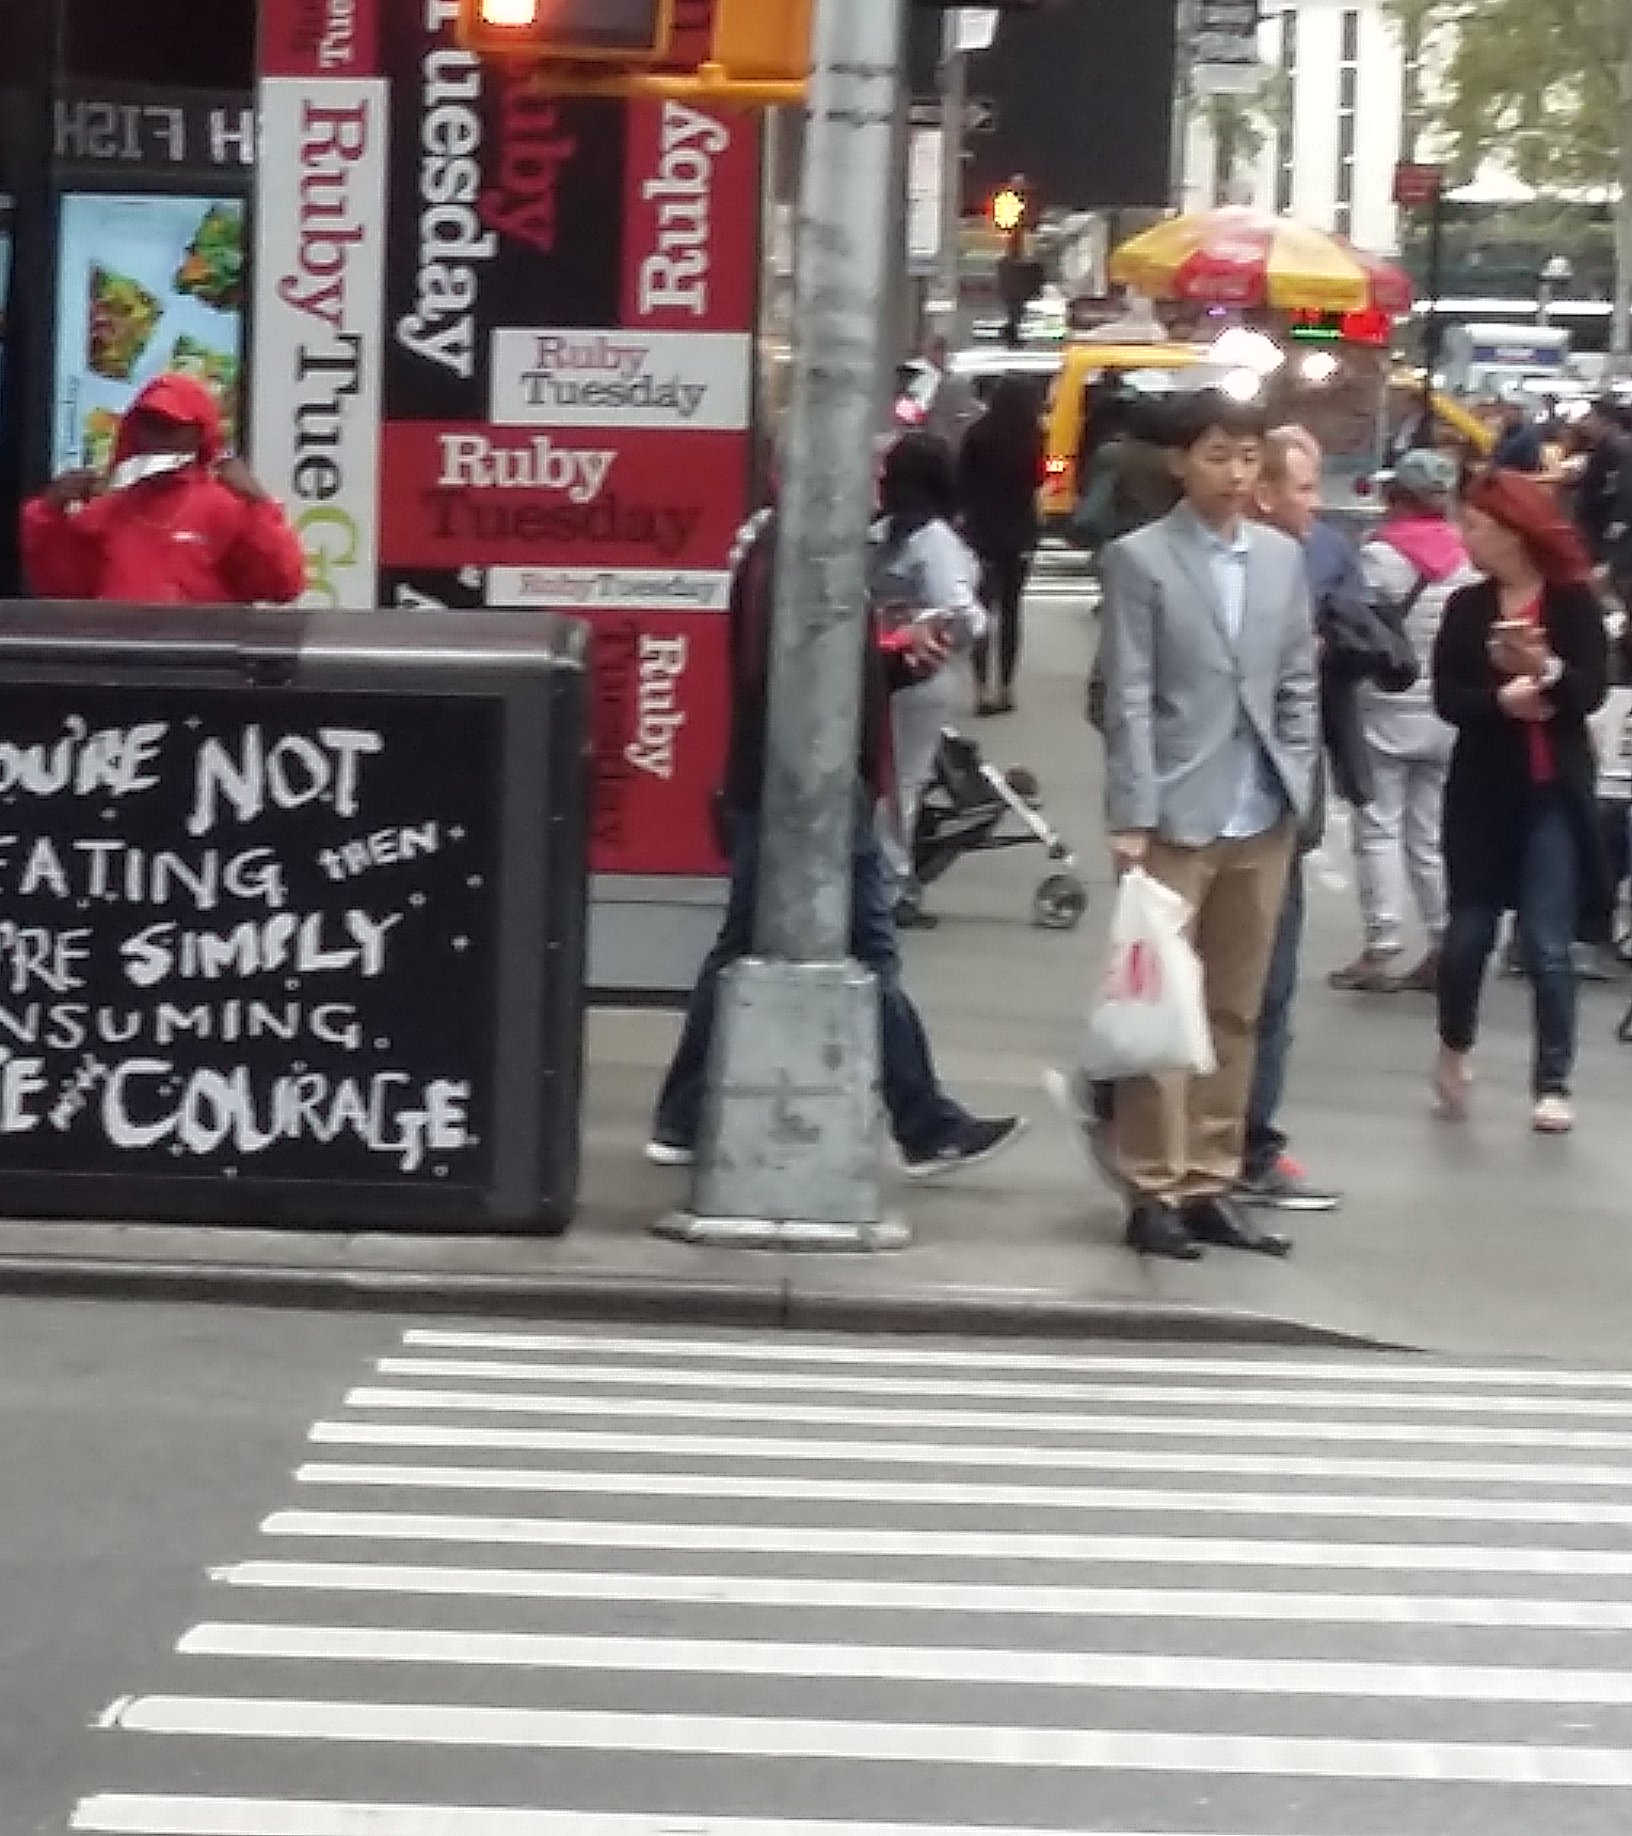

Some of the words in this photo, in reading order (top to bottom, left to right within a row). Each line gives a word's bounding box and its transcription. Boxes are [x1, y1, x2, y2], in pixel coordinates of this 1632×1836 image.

[638, 99, 731, 315] Ruby
[519, 370, 708, 417] Tuesday
[534, 335, 650, 379] Ruby
[436, 434, 618, 504] Ruby
[424, 489, 703, 558] Tuesday
[624, 632, 688, 780] Ruby
[188, 722, 383, 835] NOT
[118, 908, 404, 988] SIMPLY
[101, 1054, 472, 1172] COURAGE
